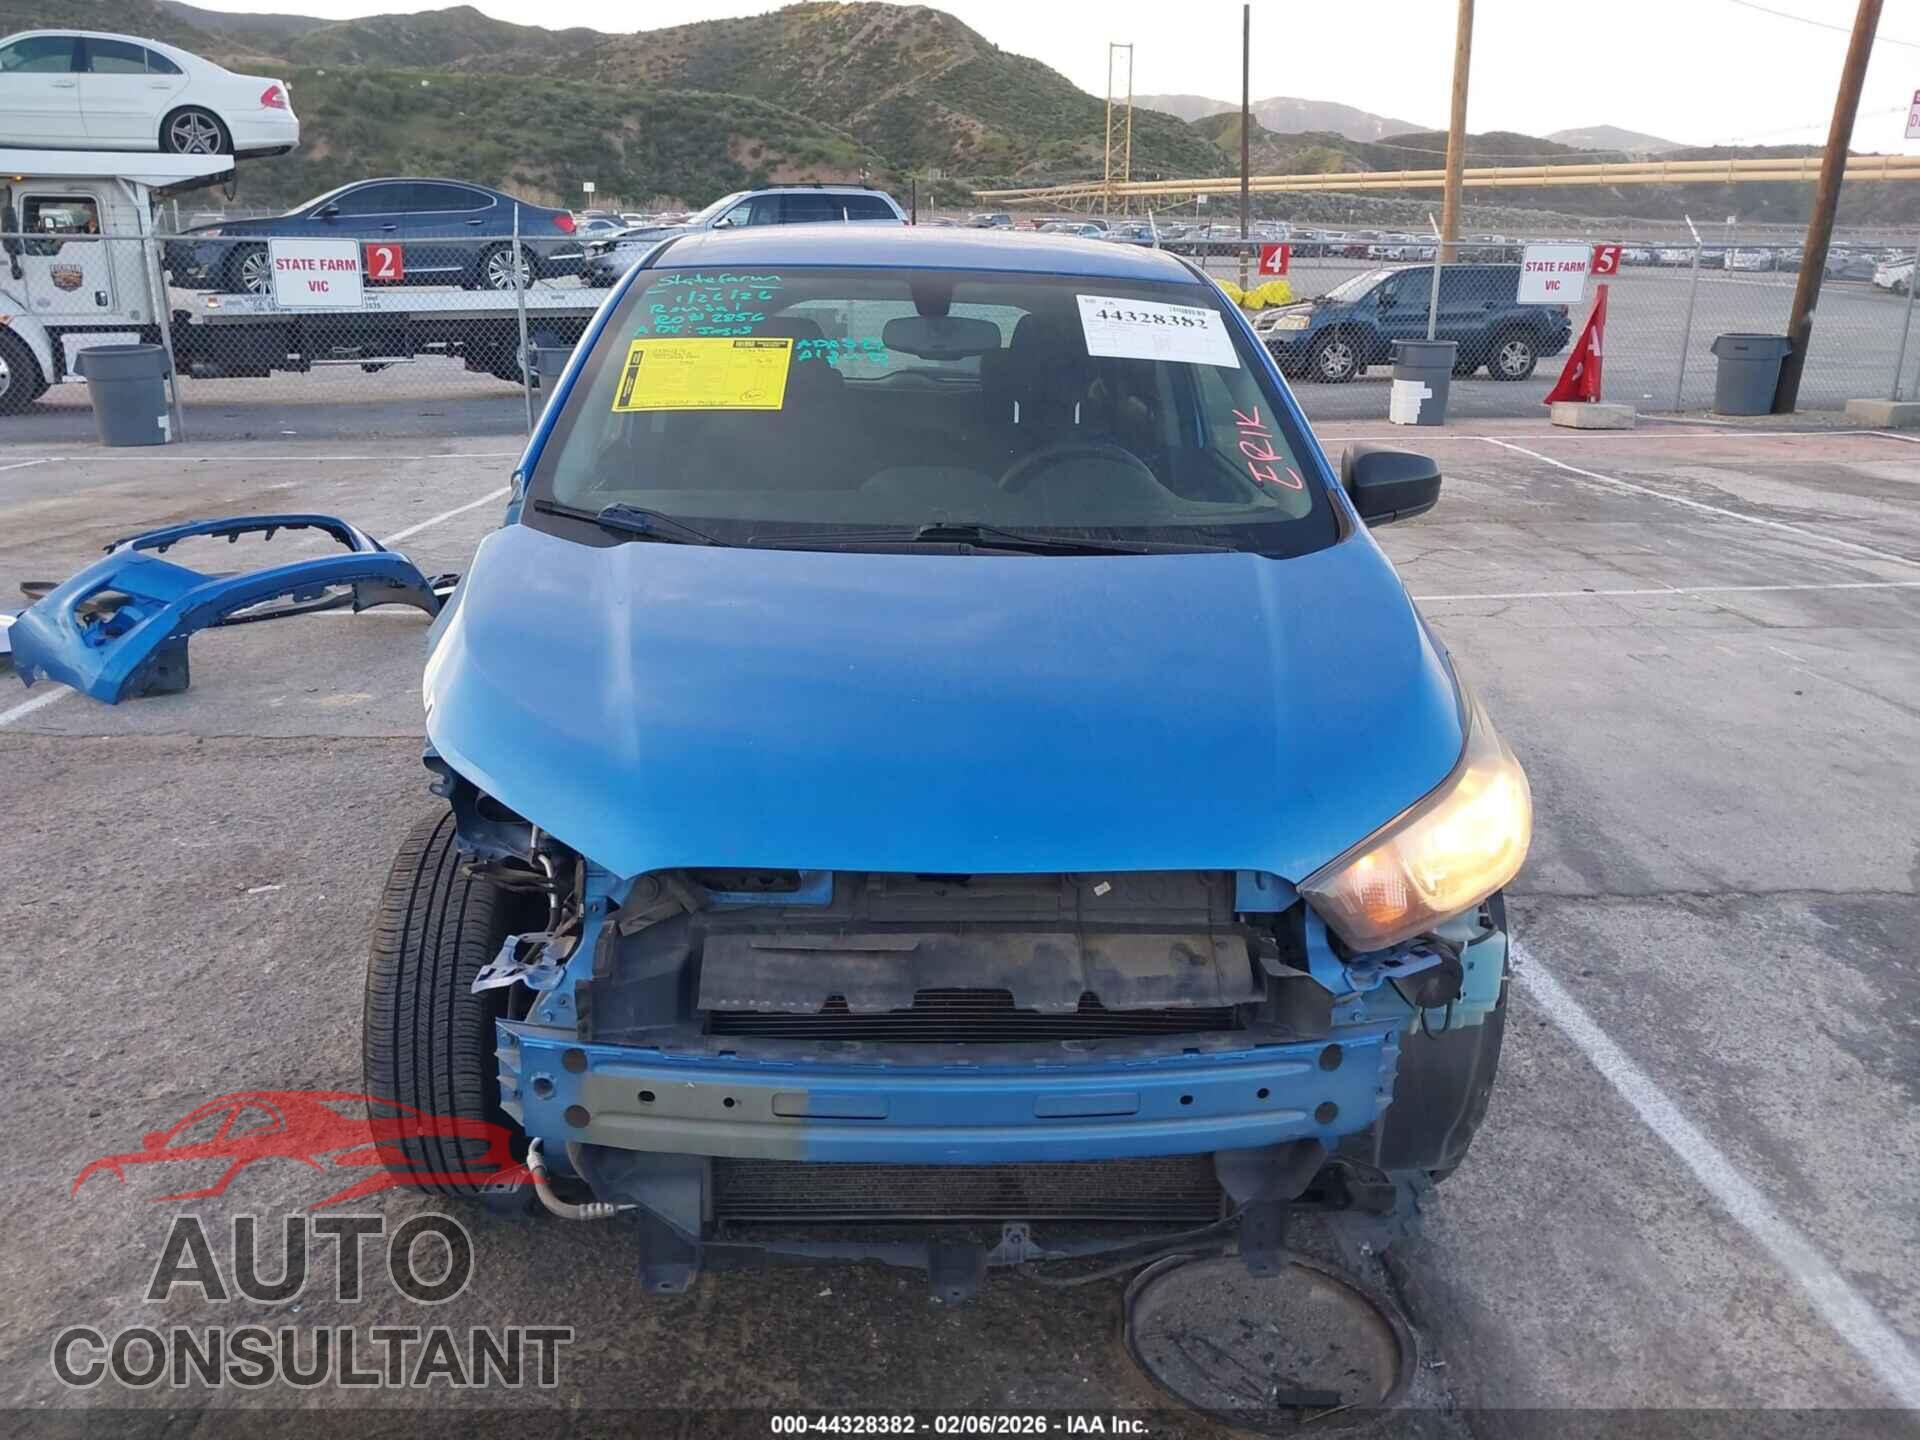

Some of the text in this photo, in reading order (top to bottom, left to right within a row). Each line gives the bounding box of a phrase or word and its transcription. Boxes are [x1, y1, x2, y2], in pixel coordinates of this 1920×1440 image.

[275, 258, 357, 271] STATE FARM
[375, 247, 396, 277] 2
[1265, 247, 1282, 273] 4
[1525, 261, 1586, 272] STATE FARM
[1597, 247, 1616, 273] 5
[307, 280, 329, 293] VIC
[1545, 279, 1561, 290] VIC
[1096, 309, 1209, 329] 44328382
